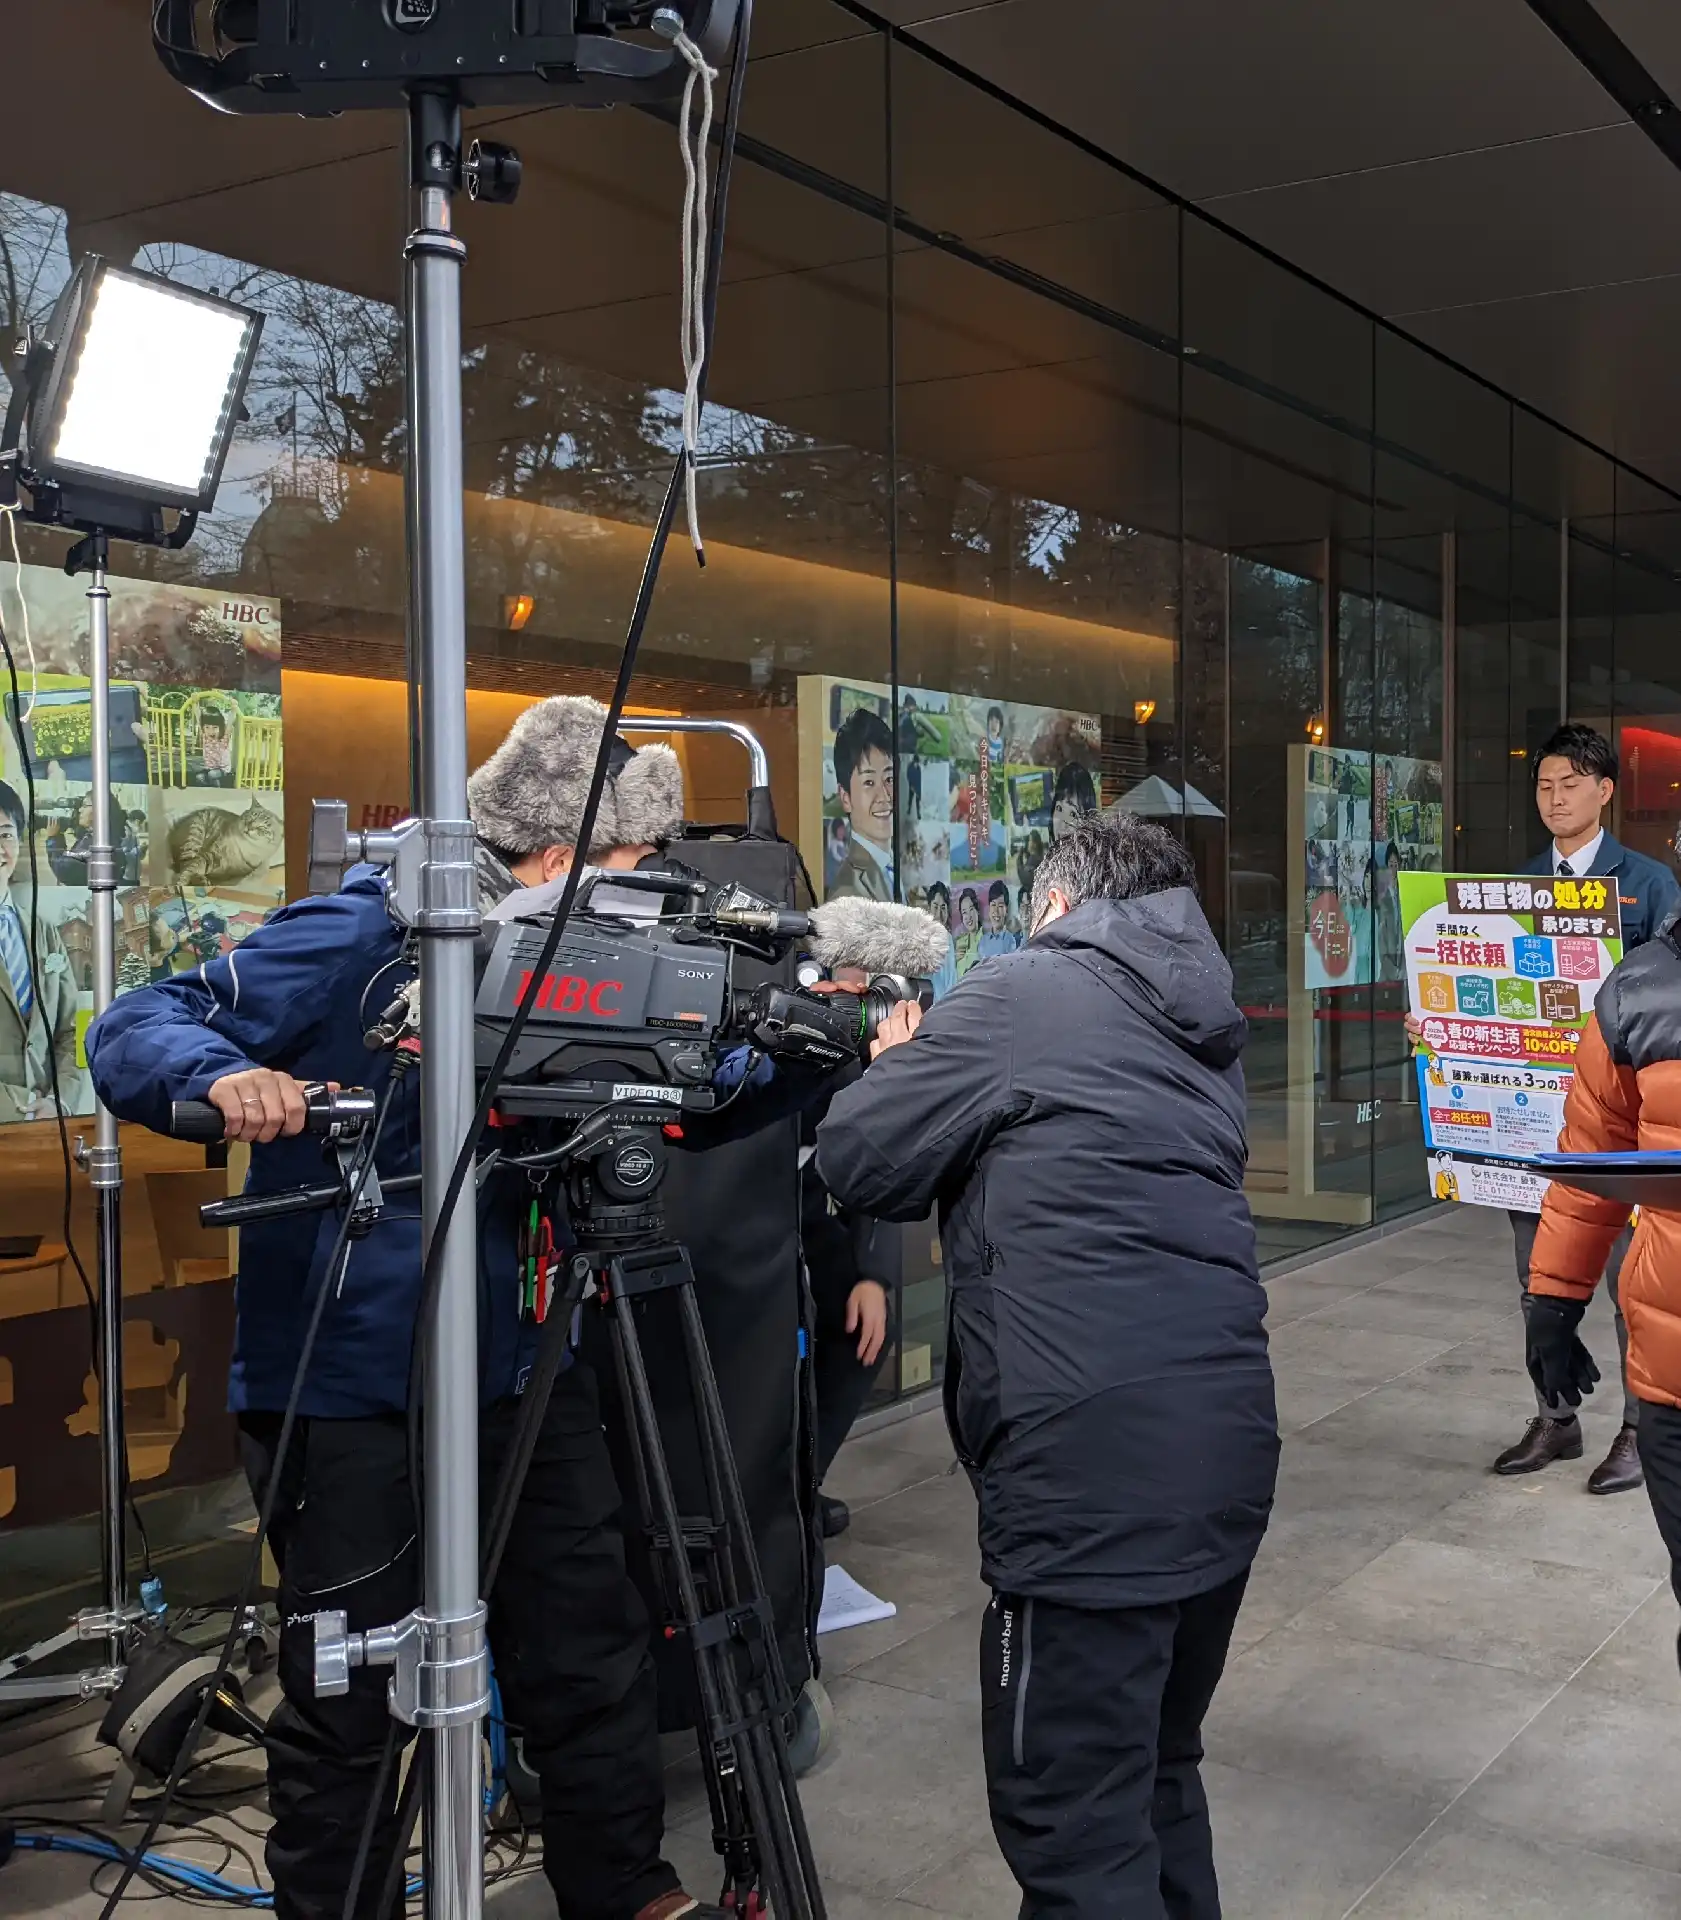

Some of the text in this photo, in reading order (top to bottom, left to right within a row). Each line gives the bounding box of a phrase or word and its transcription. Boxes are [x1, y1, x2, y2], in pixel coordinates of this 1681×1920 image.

[222, 601, 270, 624] HBC
[1080, 718, 1098, 731] HBC
[1456, 880, 1607, 910] 残置物の処分
[1436, 923, 1480, 937] 手間なく
[1541, 915, 1615, 936] 承ります。
[1415, 939, 1507, 968] 一括依頼
[677, 969, 715, 980] SONY
[513, 969, 624, 1018] HBC
[1448, 1022, 1520, 1046] 春の新生活
[1448, 1040, 1521, 1055] 応援キャンペーン
[1524, 1037, 1577, 1054] 10%OFF
[1483, 1169, 1517, 1183] 株式会社
[1472, 1183, 1488, 1193] TEL
[1491, 1186, 1543, 1201] 011-376-19
